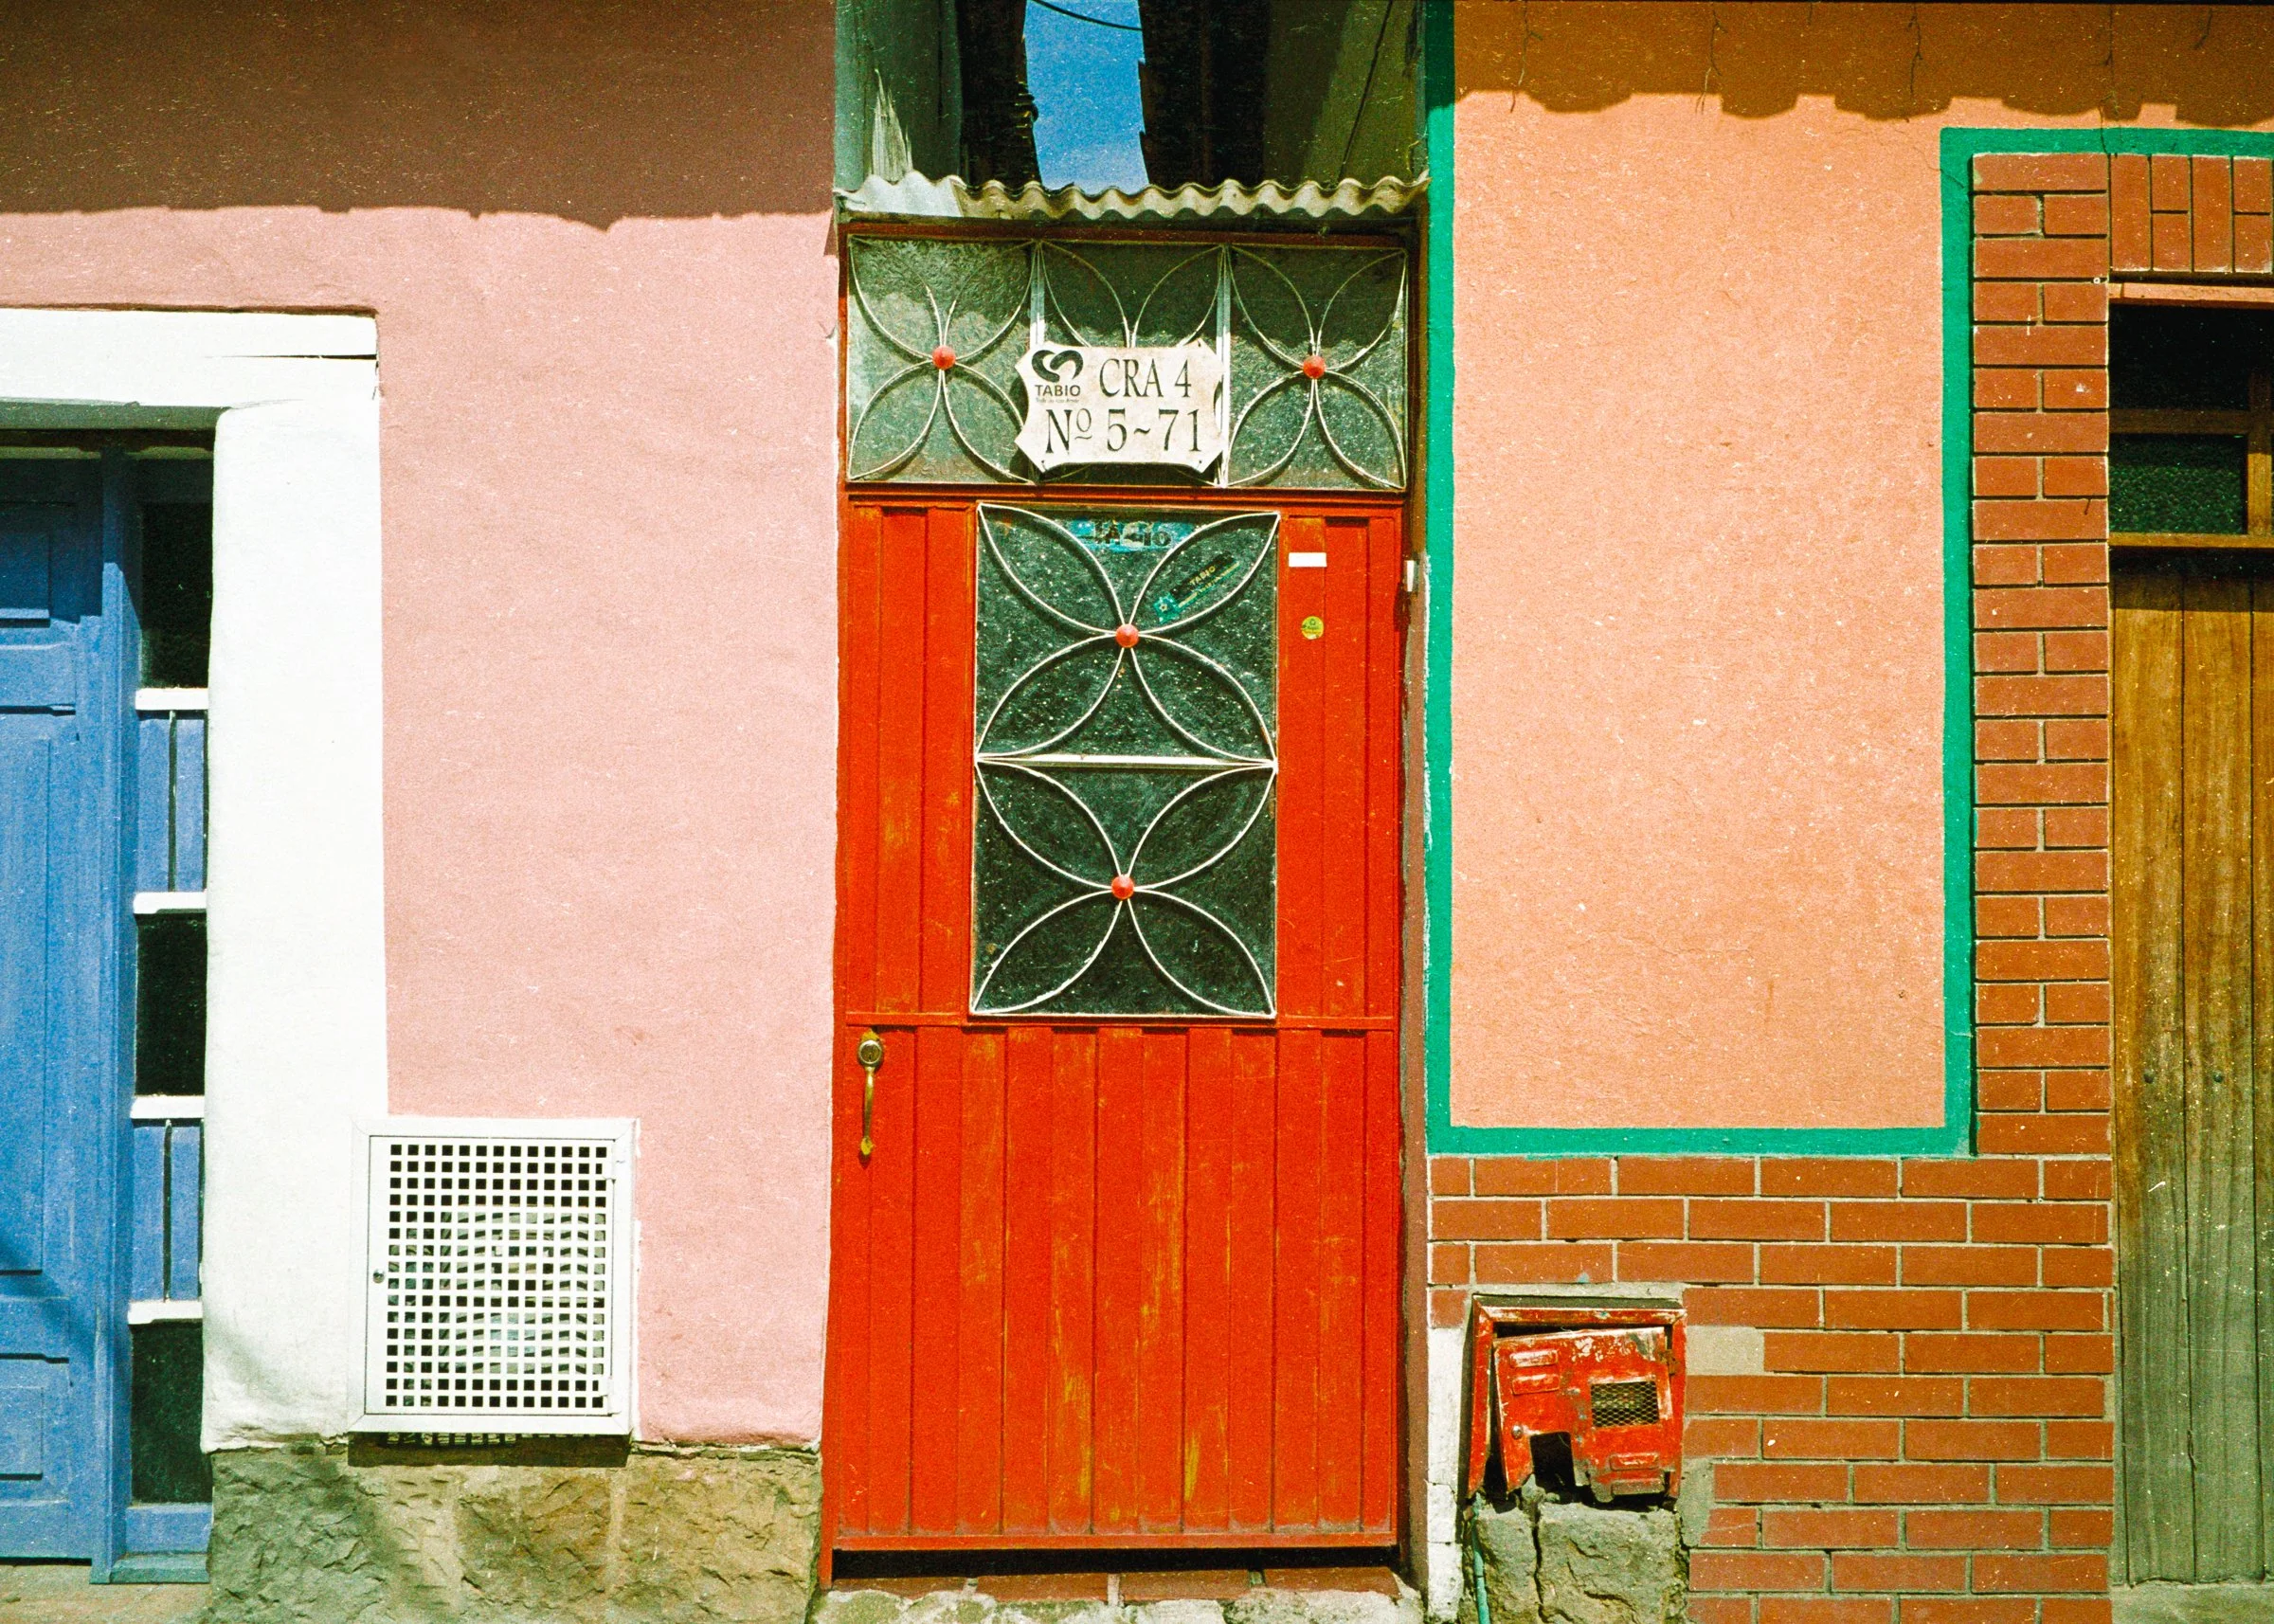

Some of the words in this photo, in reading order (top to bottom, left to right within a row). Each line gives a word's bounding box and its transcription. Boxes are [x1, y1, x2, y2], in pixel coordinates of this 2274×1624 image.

[1099, 358, 1164, 398] CRA
[1174, 358, 1192, 398] 4
[1034, 384, 1081, 397] TABIO
[1189, 565, 1216, 586] TABIO
